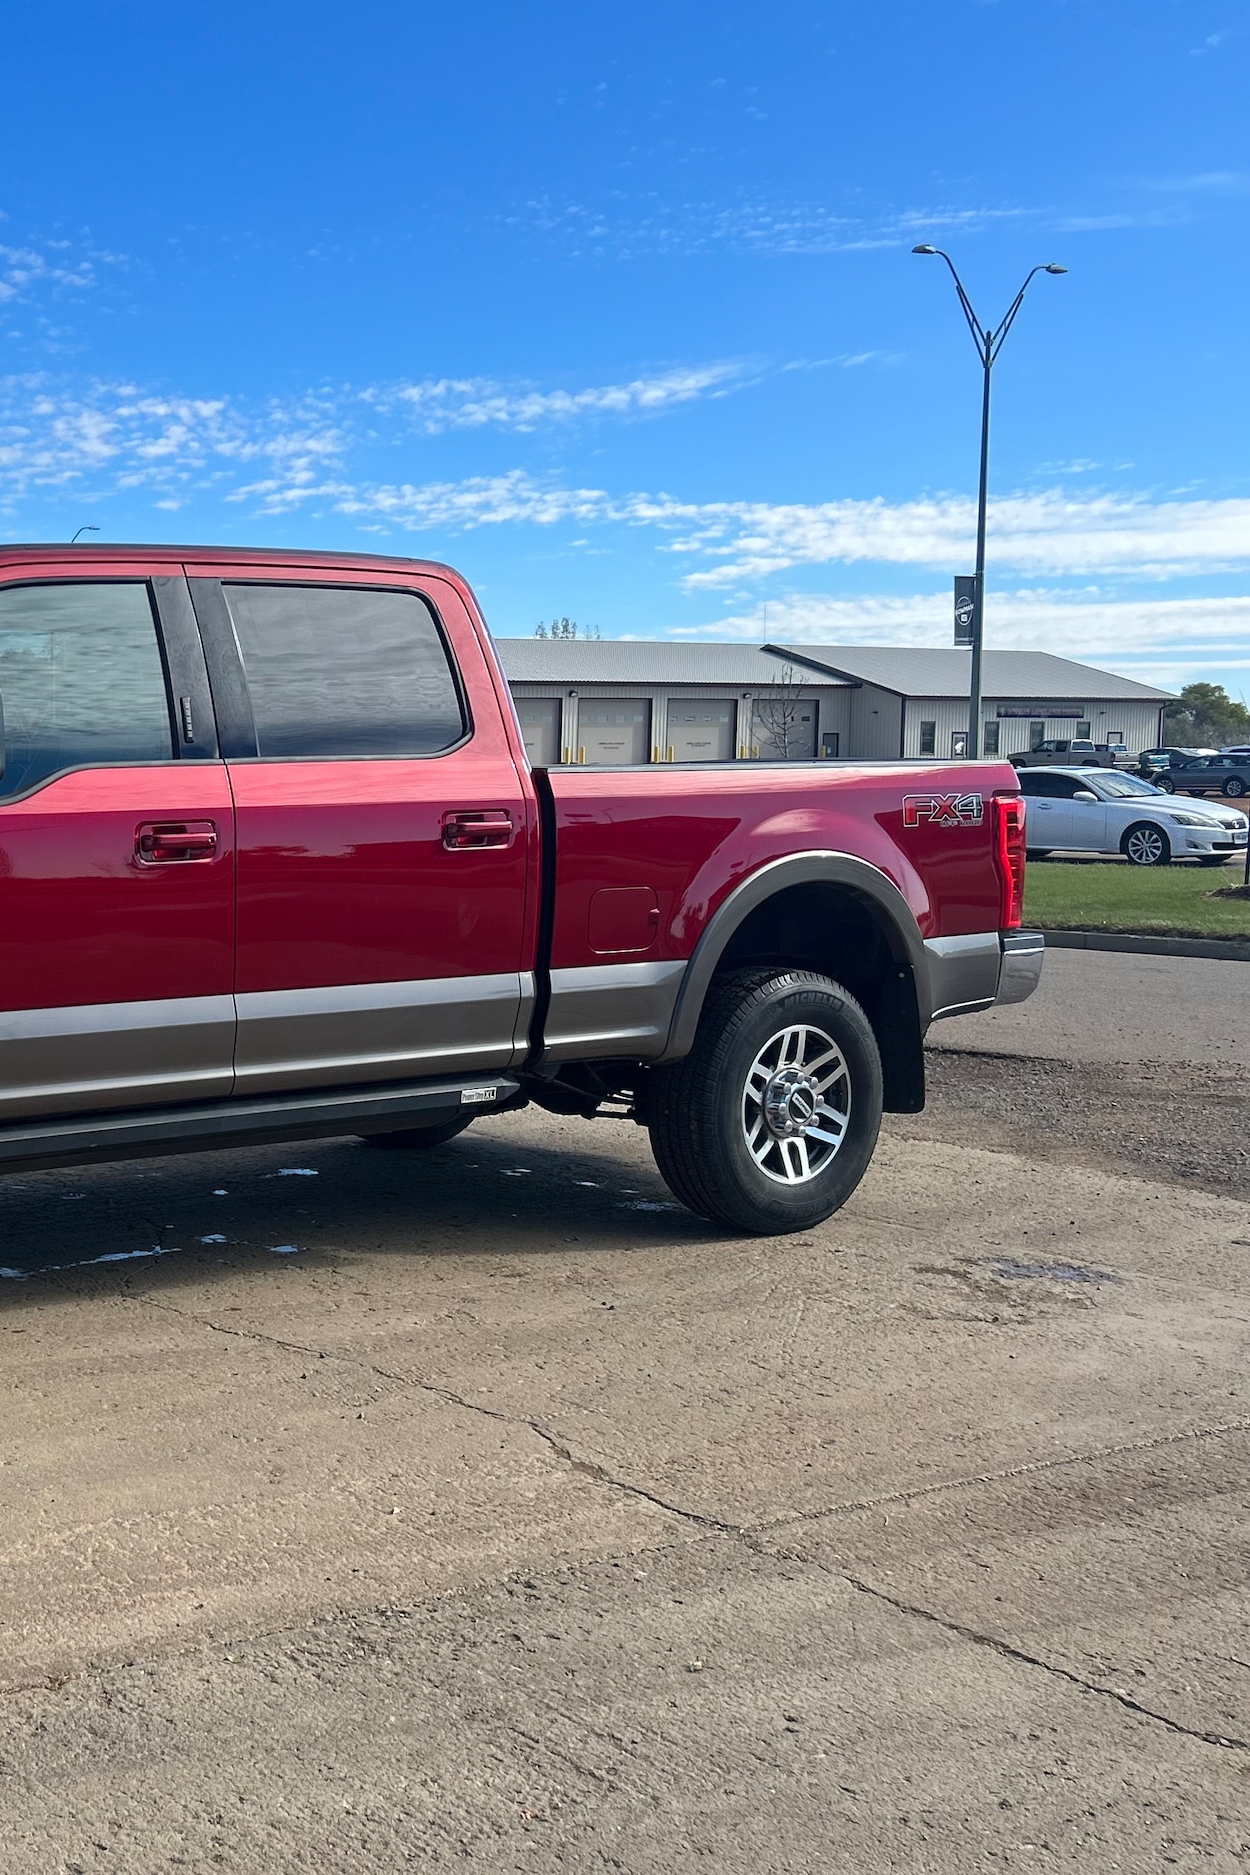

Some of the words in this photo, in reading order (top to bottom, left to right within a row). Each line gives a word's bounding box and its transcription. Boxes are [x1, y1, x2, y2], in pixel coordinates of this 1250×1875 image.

[902, 792, 983, 828] FX4
[784, 991, 844, 1012] MICHELIN
[484, 1090, 496, 1100] XL
